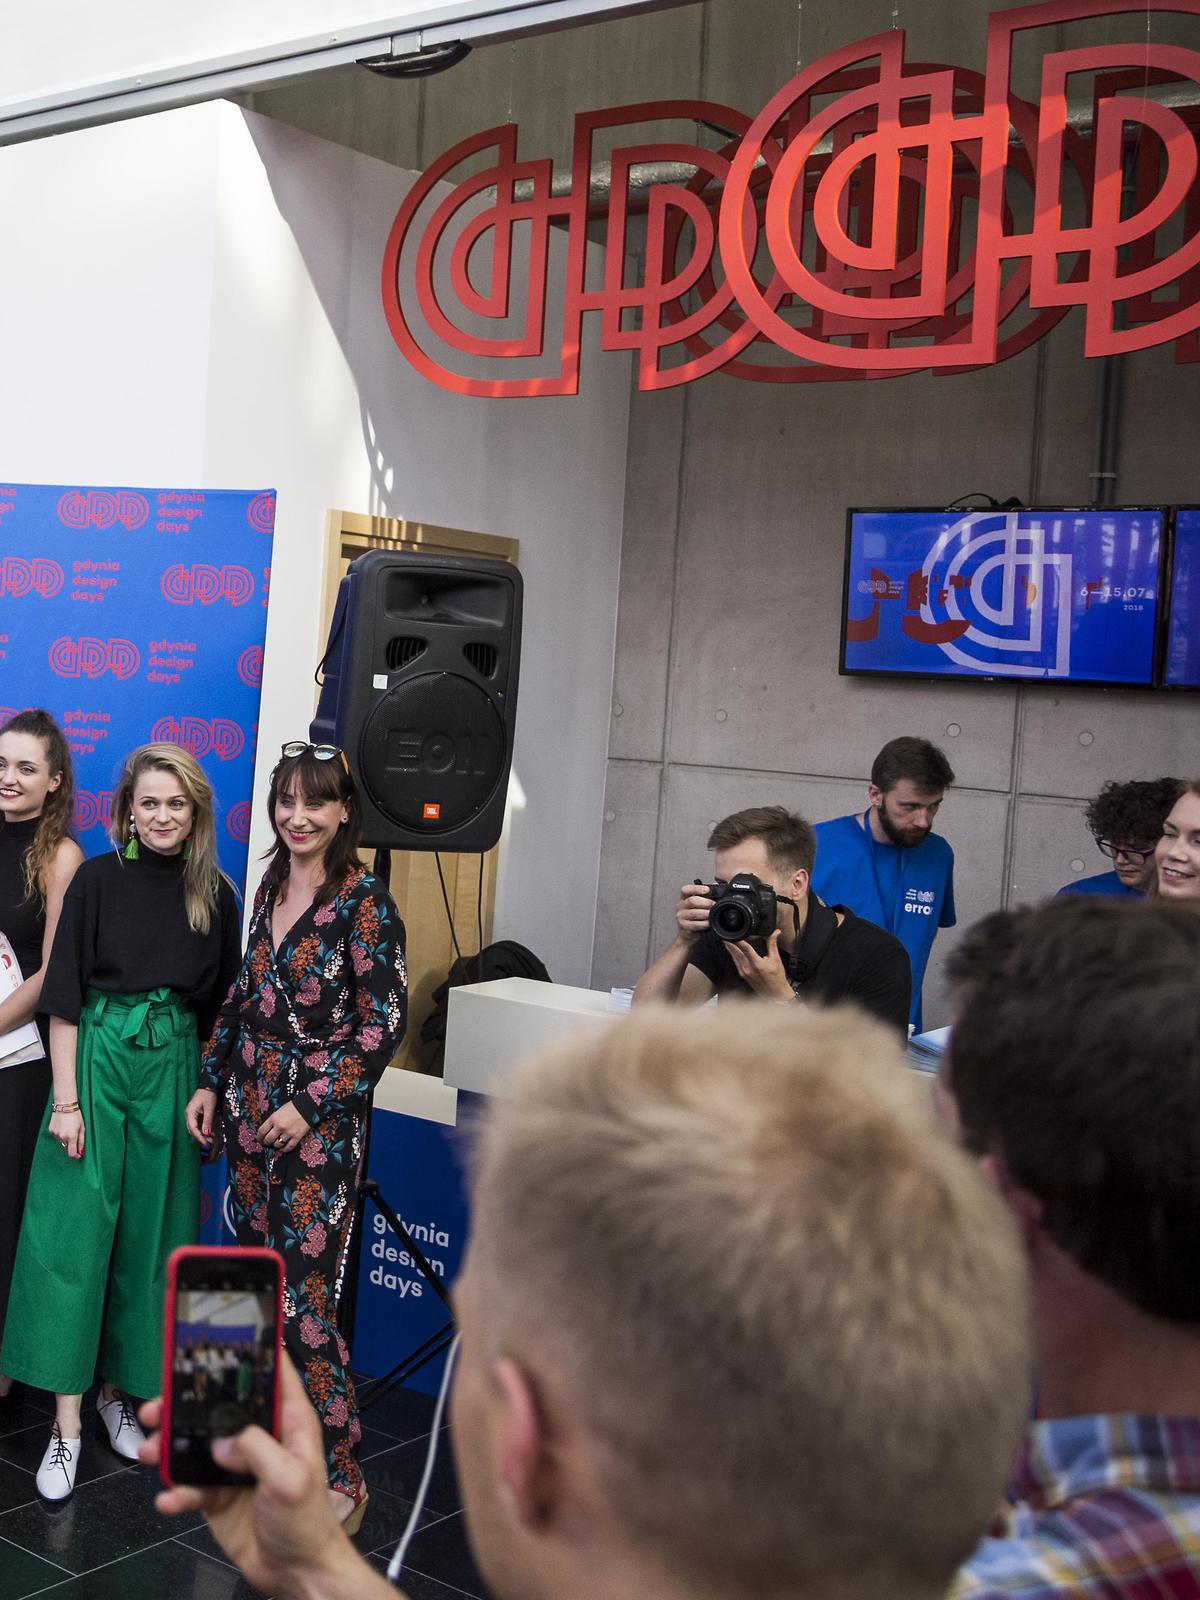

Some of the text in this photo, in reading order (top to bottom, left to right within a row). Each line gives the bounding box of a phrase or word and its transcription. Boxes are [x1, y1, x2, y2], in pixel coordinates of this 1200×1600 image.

[158, 491, 204, 505] gdynia
[156, 506, 203, 520] design
[156, 521, 189, 533] days
[73, 560, 120, 573] gdynia
[72, 575, 117, 590] design
[71, 590, 104, 603] days
[149, 640, 196, 653] gdynia
[148, 656, 193, 671] design
[147, 671, 180, 684] days
[64, 709, 110, 723] gdynia
[64, 726, 108, 741] design
[369, 1265, 423, 1298] days
